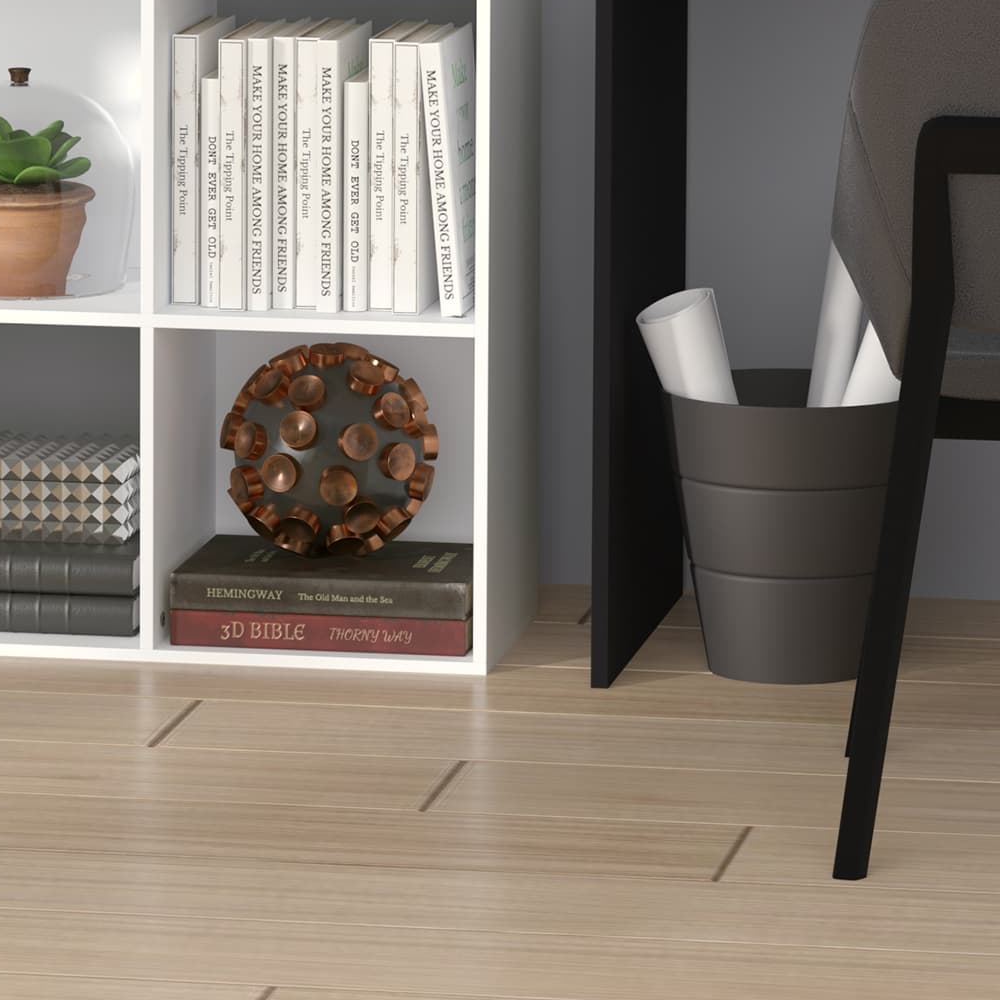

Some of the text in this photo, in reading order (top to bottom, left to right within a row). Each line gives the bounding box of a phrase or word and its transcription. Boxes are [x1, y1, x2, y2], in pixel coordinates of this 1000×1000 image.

[208, 136, 217, 165] DONT
[351, 140, 359, 169] DONT
[177, 125, 188, 215] The Tipping Point
[223, 130, 235, 221] The Tipping Point
[252, 65, 262, 295] MAKE YOUR HOME AMONG FRIENDS
[277, 63, 288, 293] MAKE YOUR HOME AMONG FRIENDS
[300, 128, 311, 219] The Tipping Point
[321, 67, 332, 297] MAKE YOUR HOME AMONG FRIENDS
[374, 130, 385, 221] The Tipping Point
[398, 133, 409, 225] The Tipping Point
[208, 172, 217, 201] EVER
[351, 176, 359, 205] EVER
[426, 70, 454, 300] MAKE YOUR HOME AMONG FRIENDS
[208, 208, 217, 230] GET
[351, 211, 359, 234] GET
[208, 236, 217, 259] OLD
[351, 240, 359, 263] OLD
[206, 587, 283, 600] HEMINGWAY
[297, 592, 393, 604] The Old Man and the Sea
[220, 621, 306, 641] 3D BIBLE
[329, 627, 413, 644] THORNY WAY
